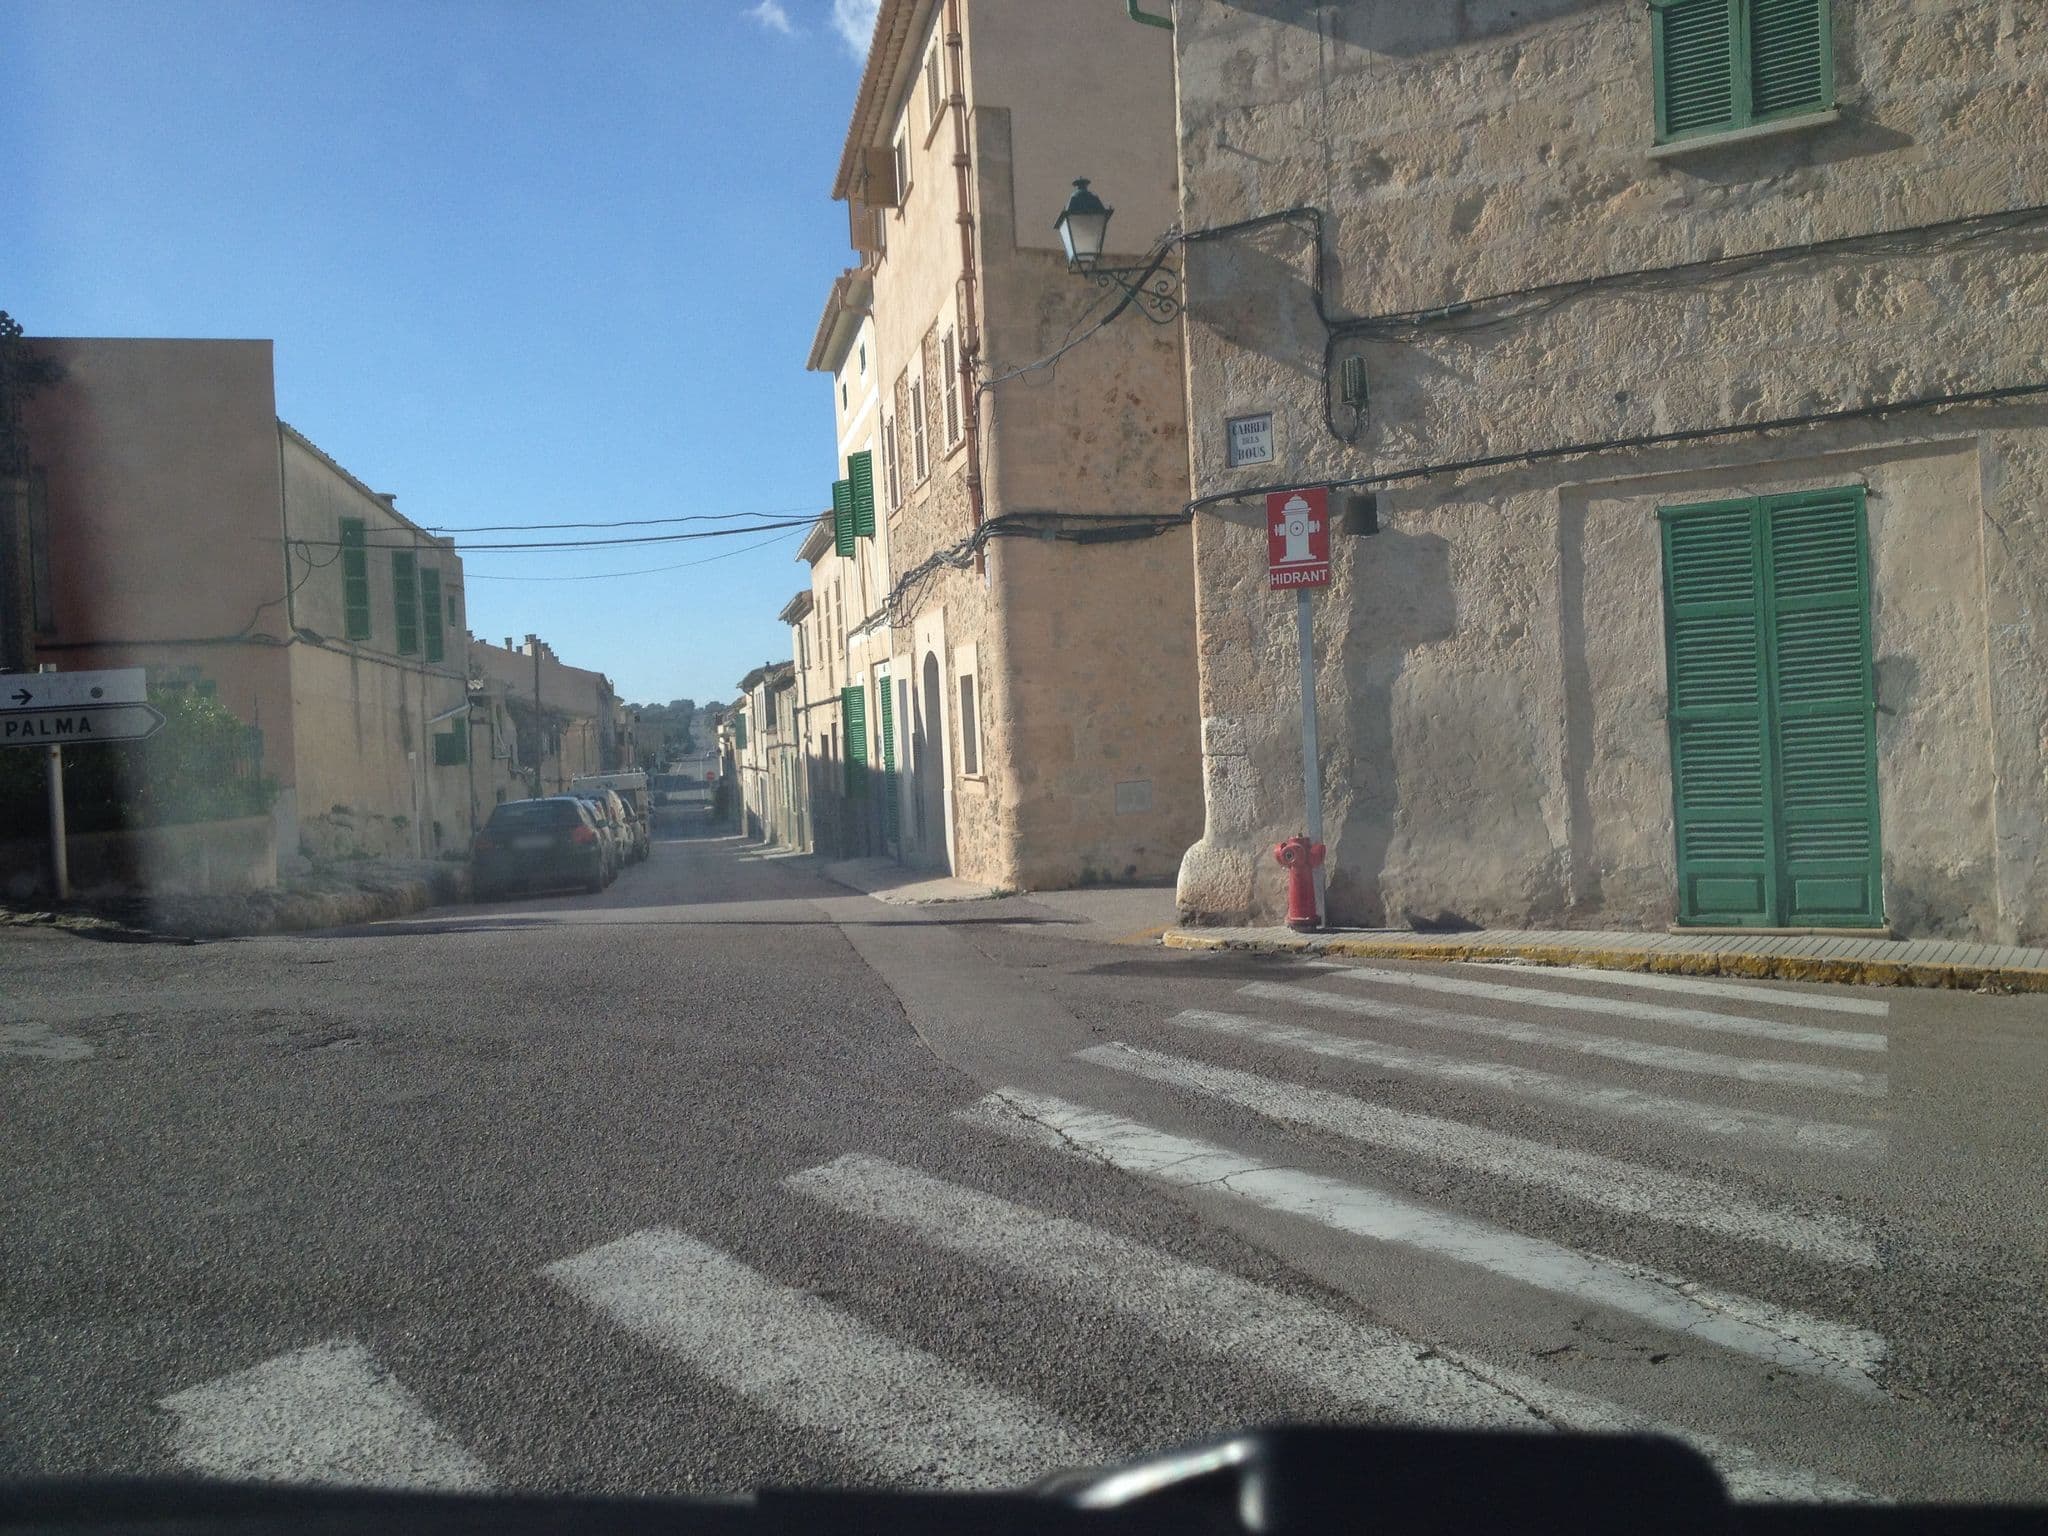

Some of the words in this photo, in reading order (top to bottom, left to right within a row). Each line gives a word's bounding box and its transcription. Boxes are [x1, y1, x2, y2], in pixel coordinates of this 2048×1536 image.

[1238, 446, 1266, 460] BOUS
[1271, 569, 1328, 585] HIDRANT
[5, 717, 92, 737] PALMA
